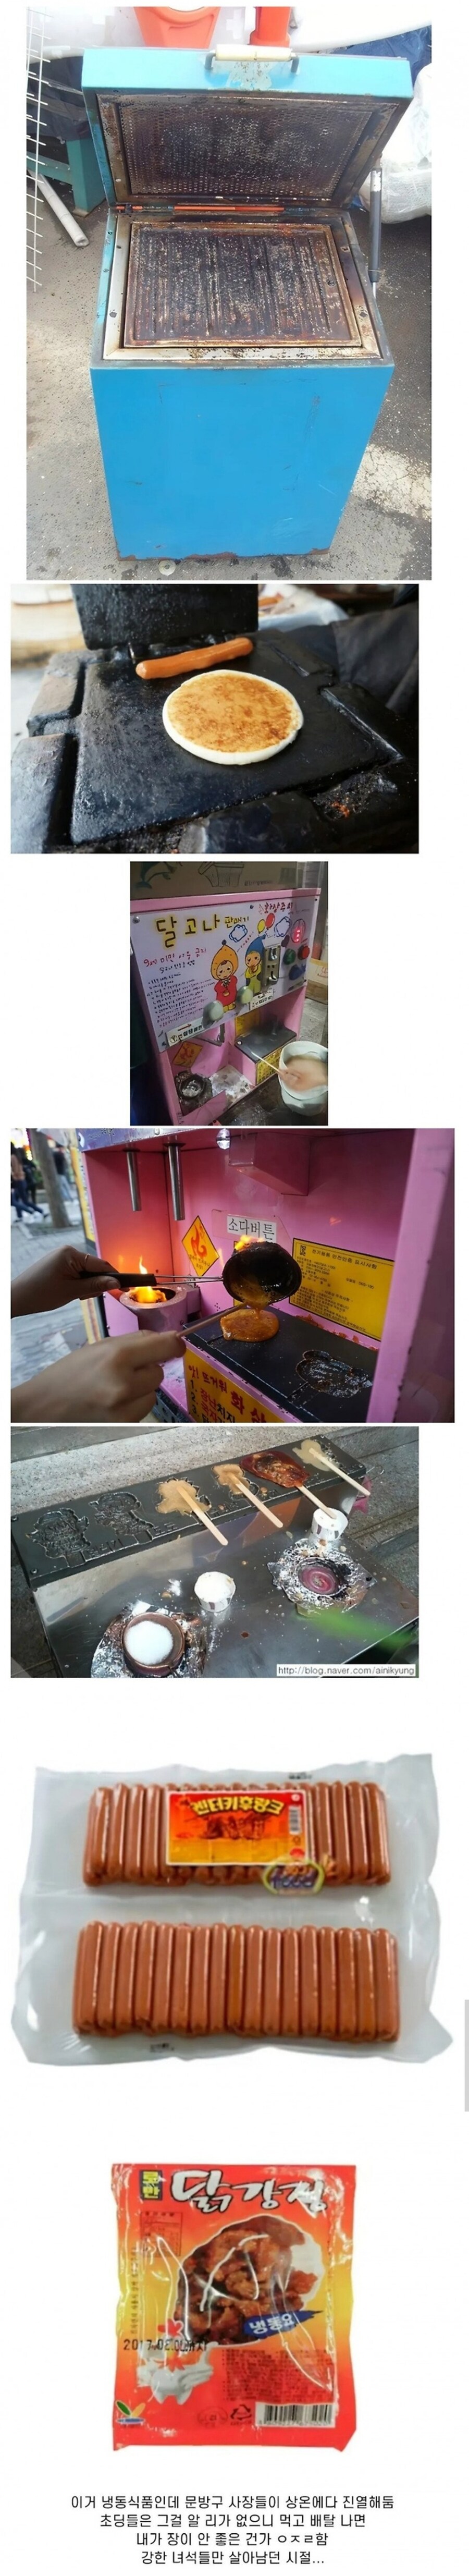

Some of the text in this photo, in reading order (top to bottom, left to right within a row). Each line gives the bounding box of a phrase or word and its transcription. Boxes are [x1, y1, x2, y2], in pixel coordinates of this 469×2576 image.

[156, 914, 220, 948] 달고나
[228, 1218, 275, 1240] 소다버튼
[188, 1364, 199, 1379] 앗!
[202, 1371, 228, 1394] 뜨거워
